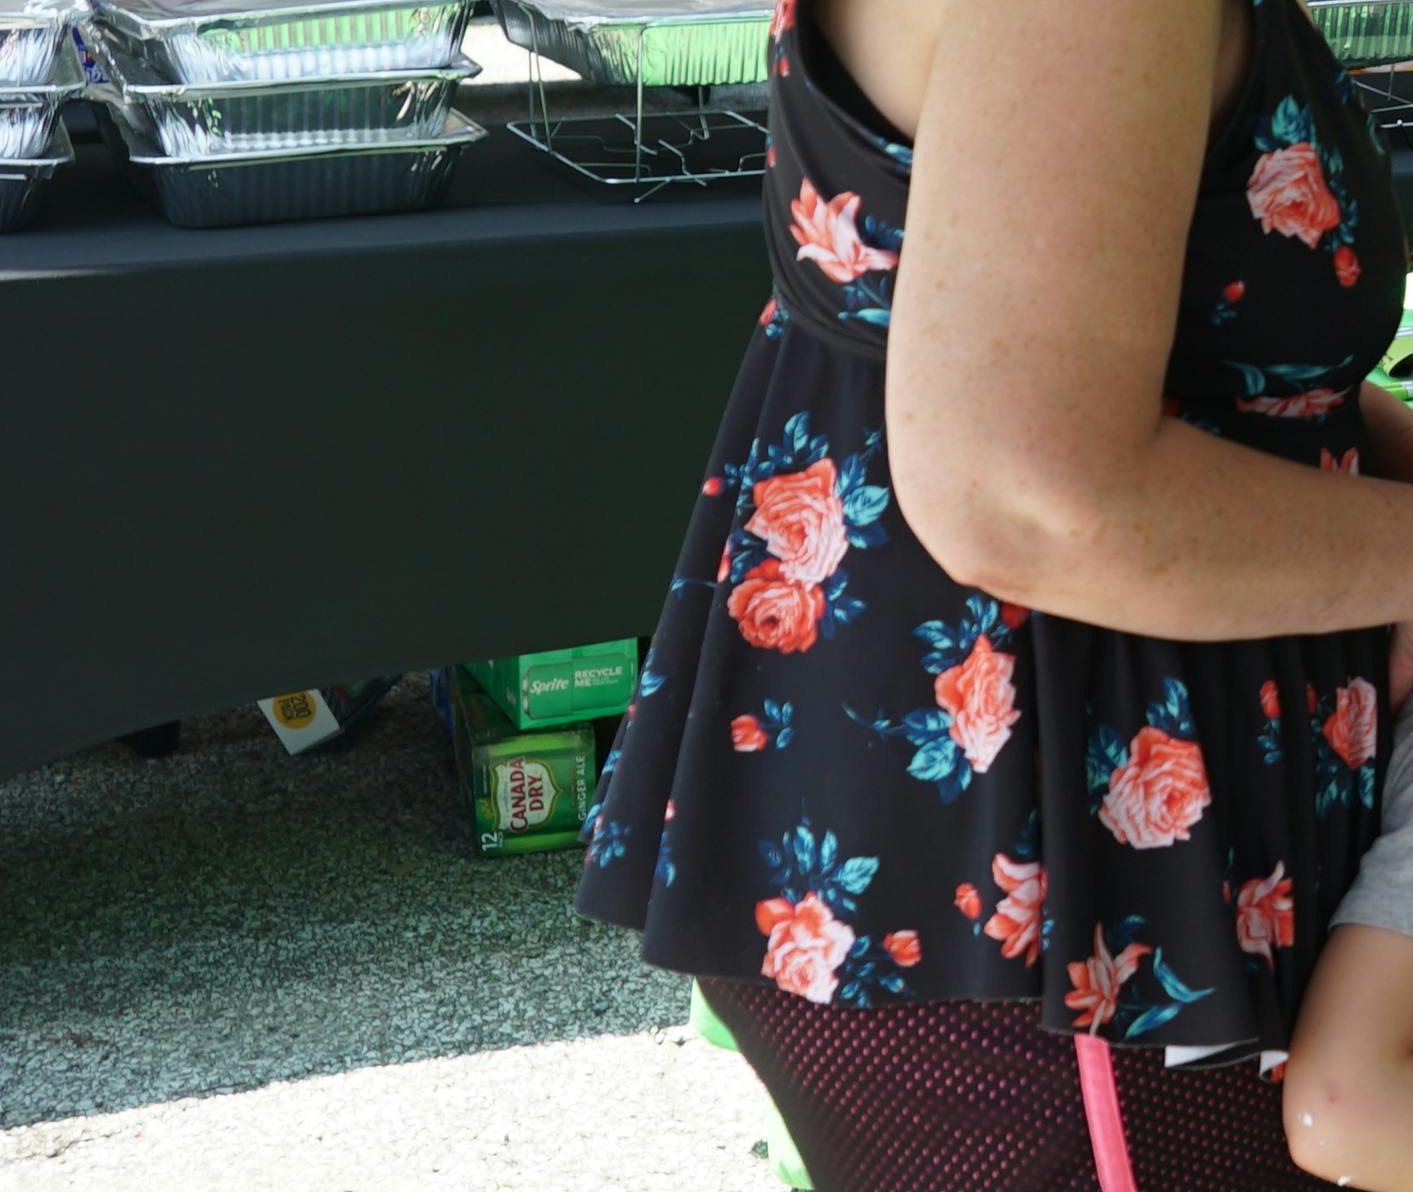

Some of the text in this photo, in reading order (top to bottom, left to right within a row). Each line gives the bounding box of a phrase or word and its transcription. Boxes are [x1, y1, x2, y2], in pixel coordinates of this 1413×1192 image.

[574, 665, 623, 679] RECYCLE
[574, 677, 592, 688] ME
[530, 676, 570, 696] Sprite
[290, 693, 312, 719] 200
[507, 756, 529, 833] CANADA
[527, 773, 545, 813] DRY
[575, 755, 588, 821] GINGER ALE
[481, 831, 498, 852] 12
